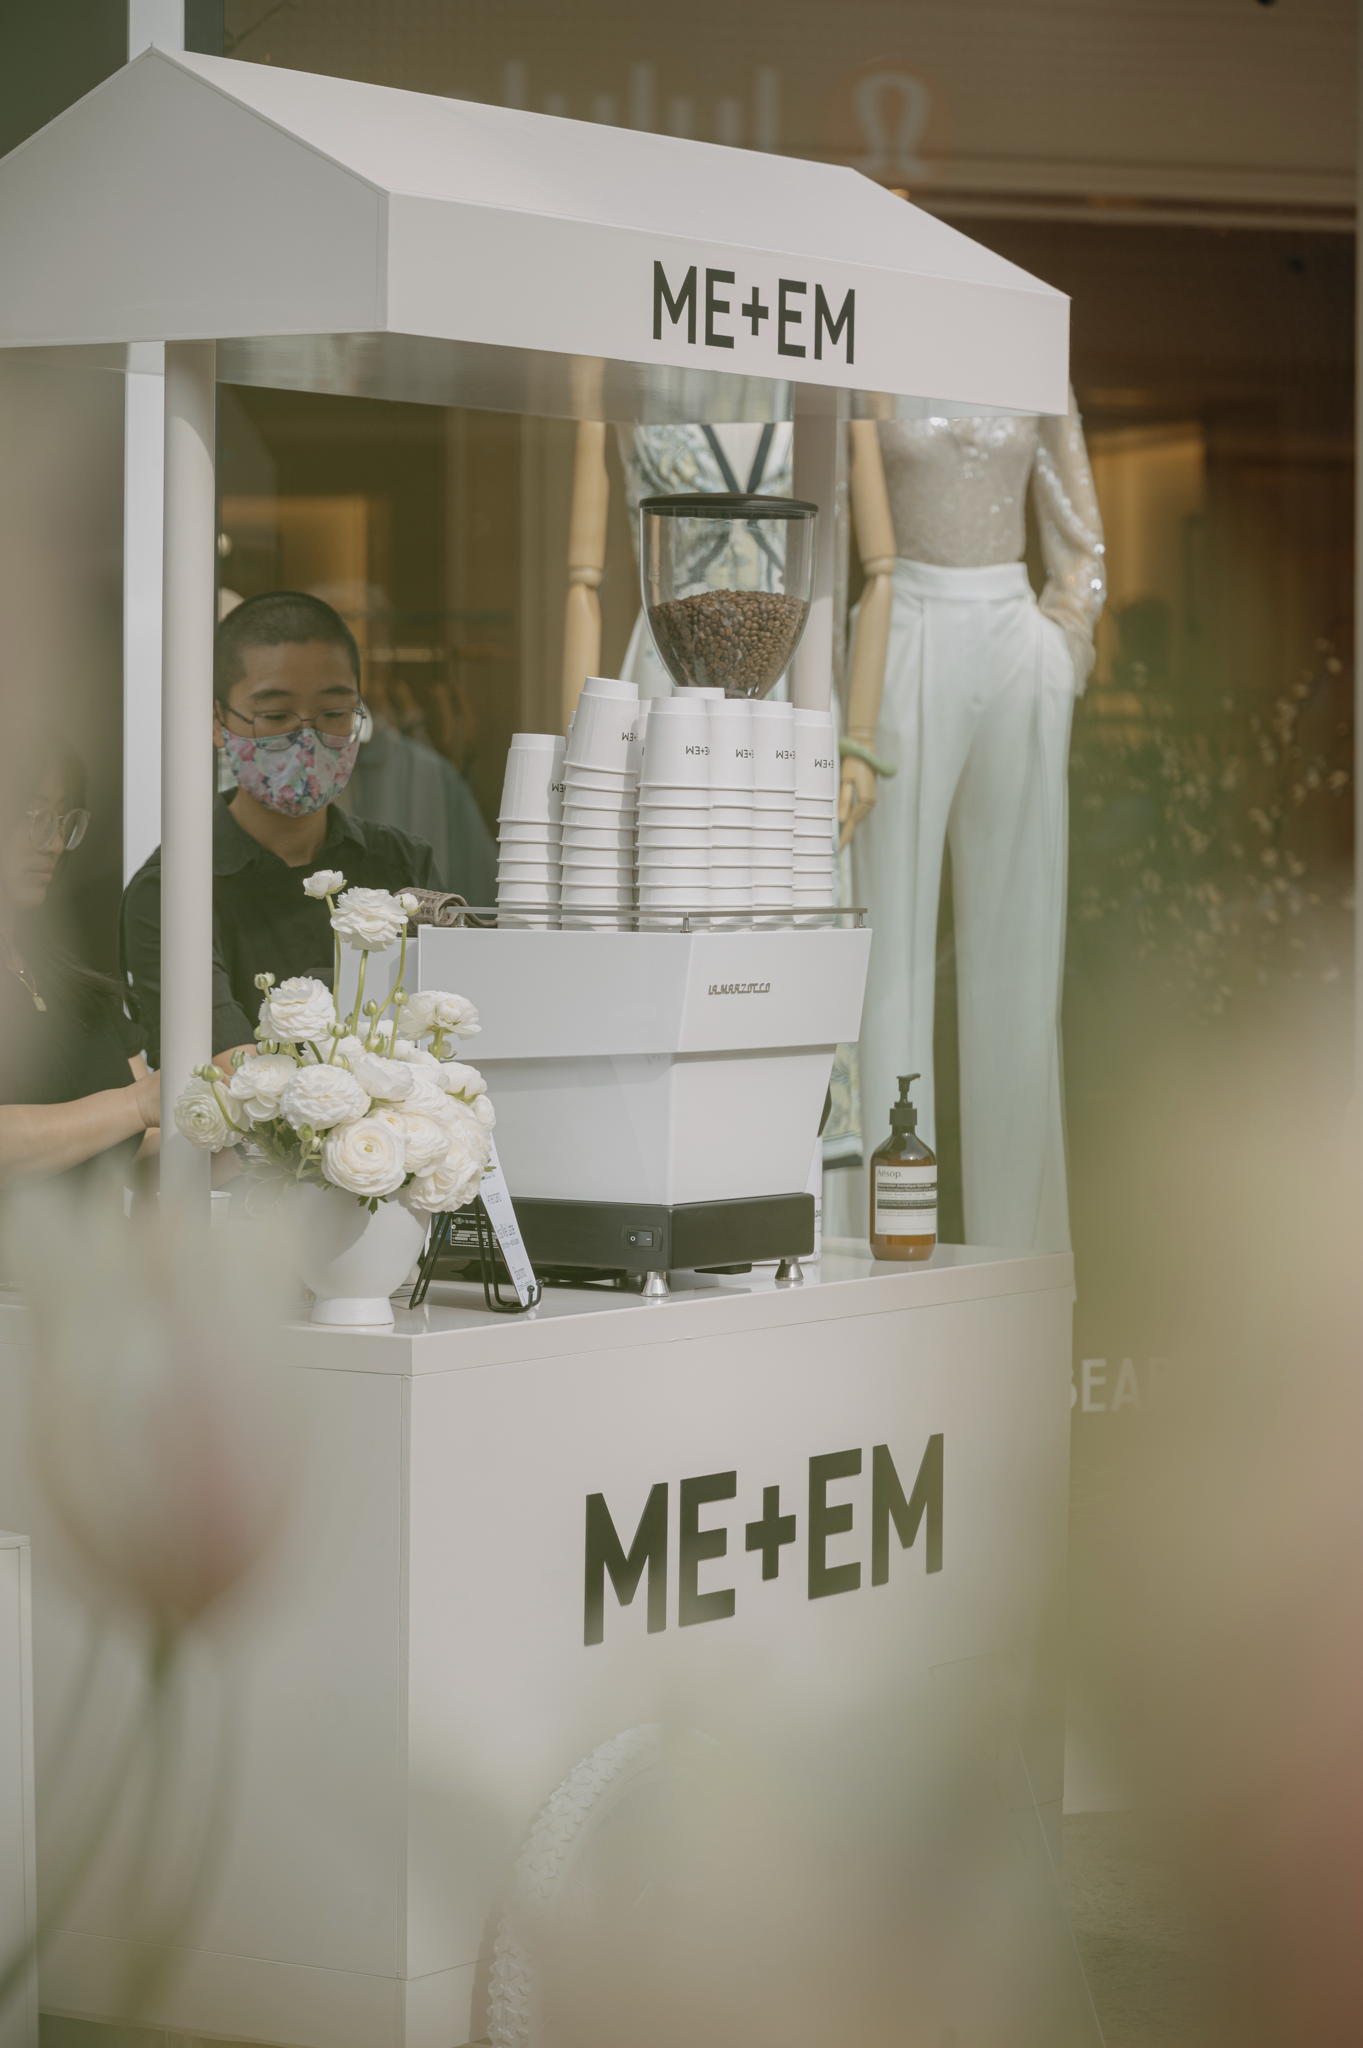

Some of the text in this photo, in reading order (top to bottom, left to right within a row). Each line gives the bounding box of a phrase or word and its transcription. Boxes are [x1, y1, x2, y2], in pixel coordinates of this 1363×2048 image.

[653, 260, 855, 365] ME+EM
[686, 745, 710, 755] E+EM
[736, 749, 754, 758] E+EM
[776, 750, 796, 759] E+EM
[814, 759, 834, 768] E+EM
[584, 1433, 944, 1647] ME+EM
